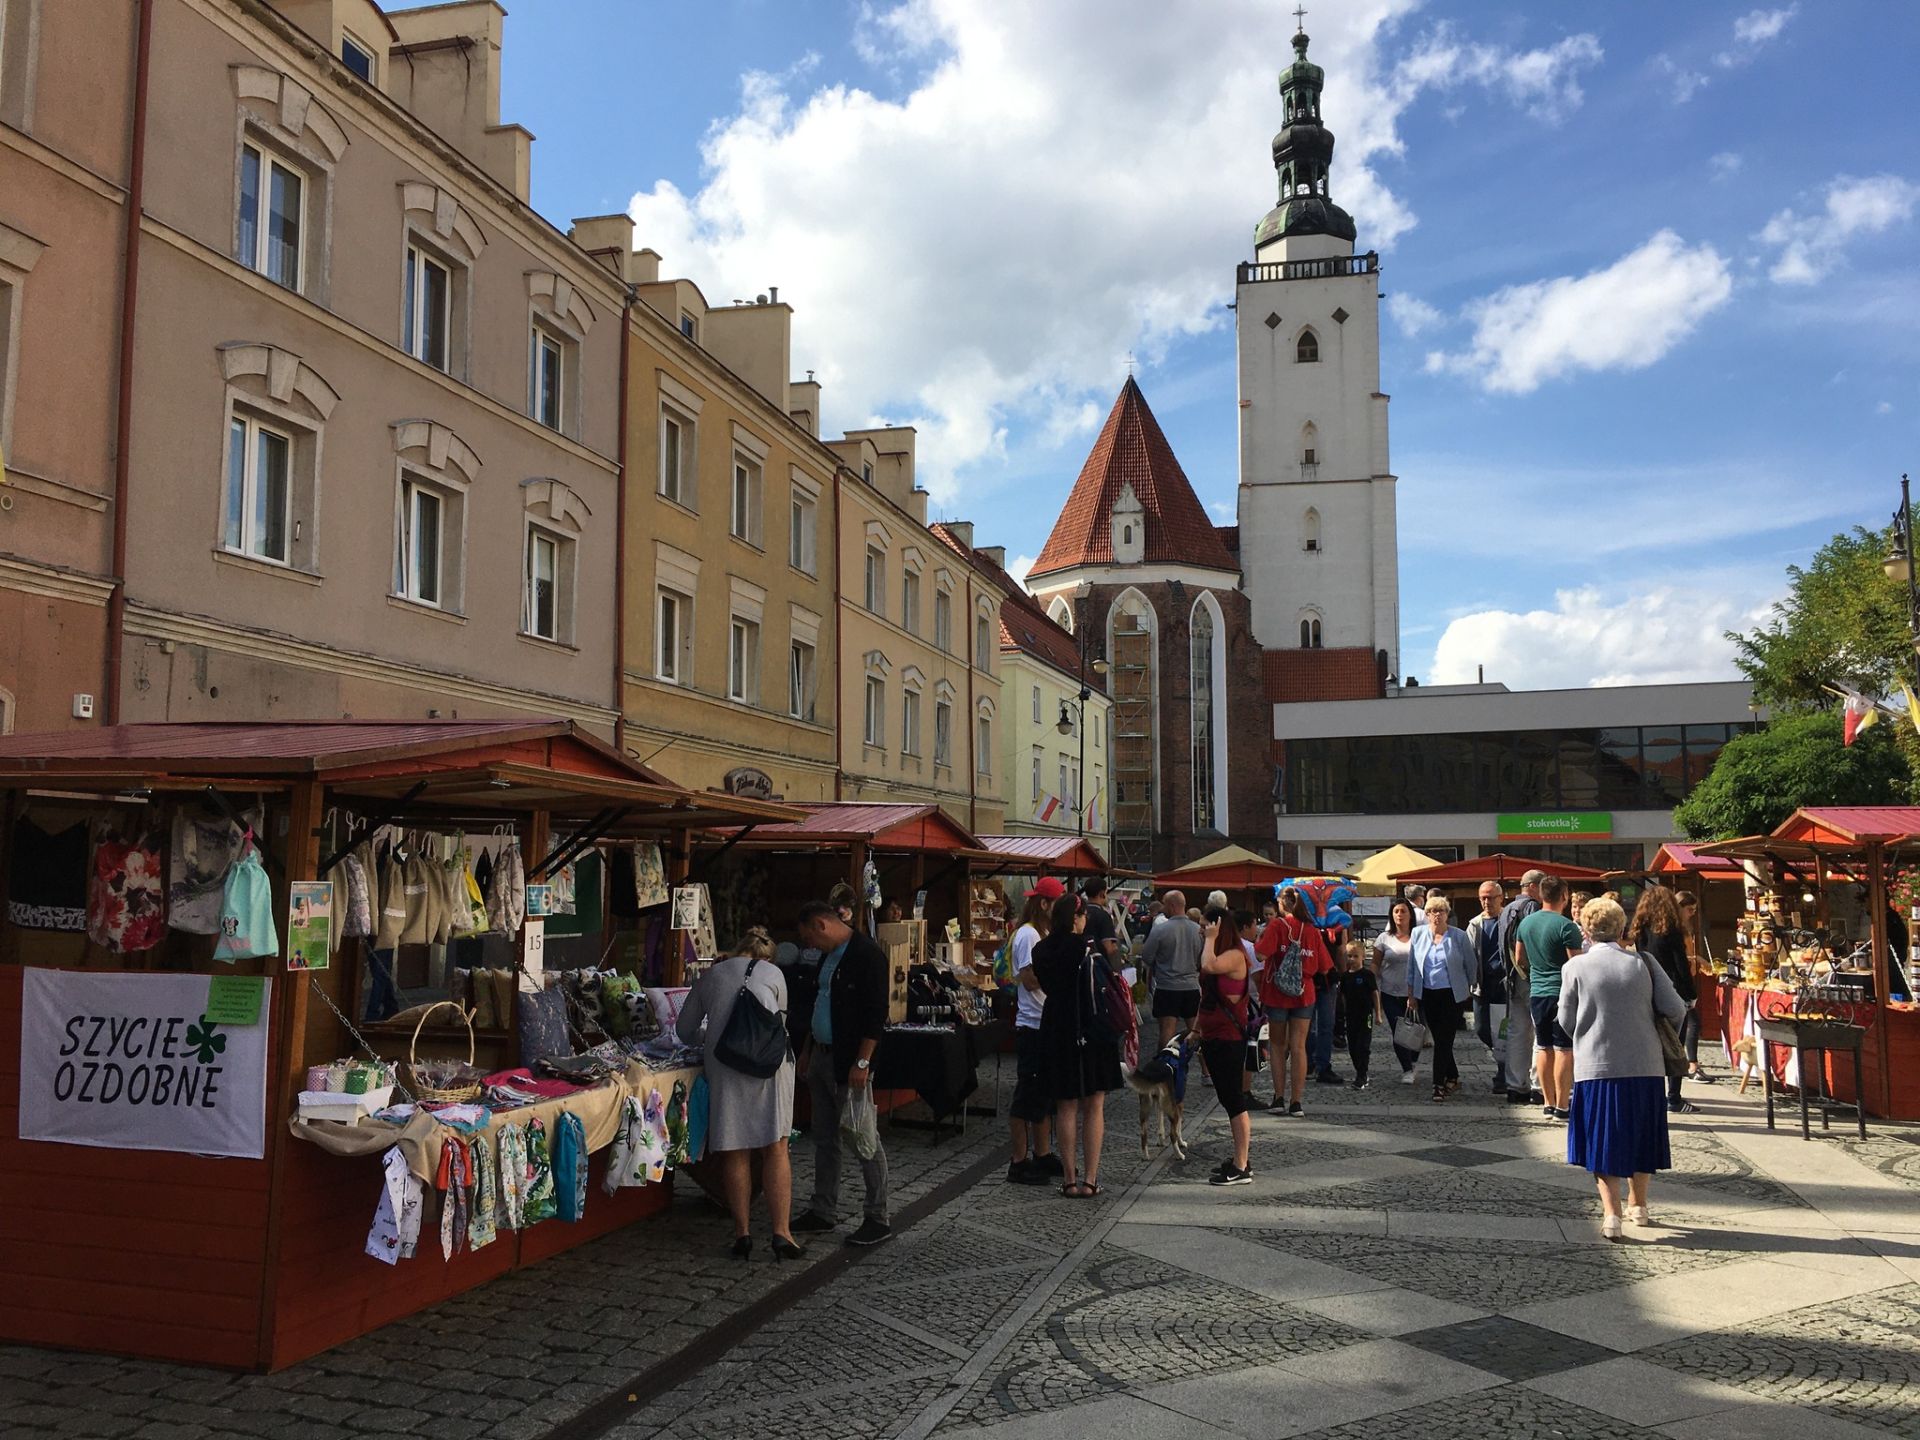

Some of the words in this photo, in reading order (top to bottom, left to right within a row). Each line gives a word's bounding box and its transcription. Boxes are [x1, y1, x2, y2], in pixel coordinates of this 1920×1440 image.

[1527, 818, 1570, 828] stokrotka
[530, 934, 541, 950] 15
[60, 1015, 184, 1059] SZYCIE
[54, 1061, 223, 1108] OZDOBNE
